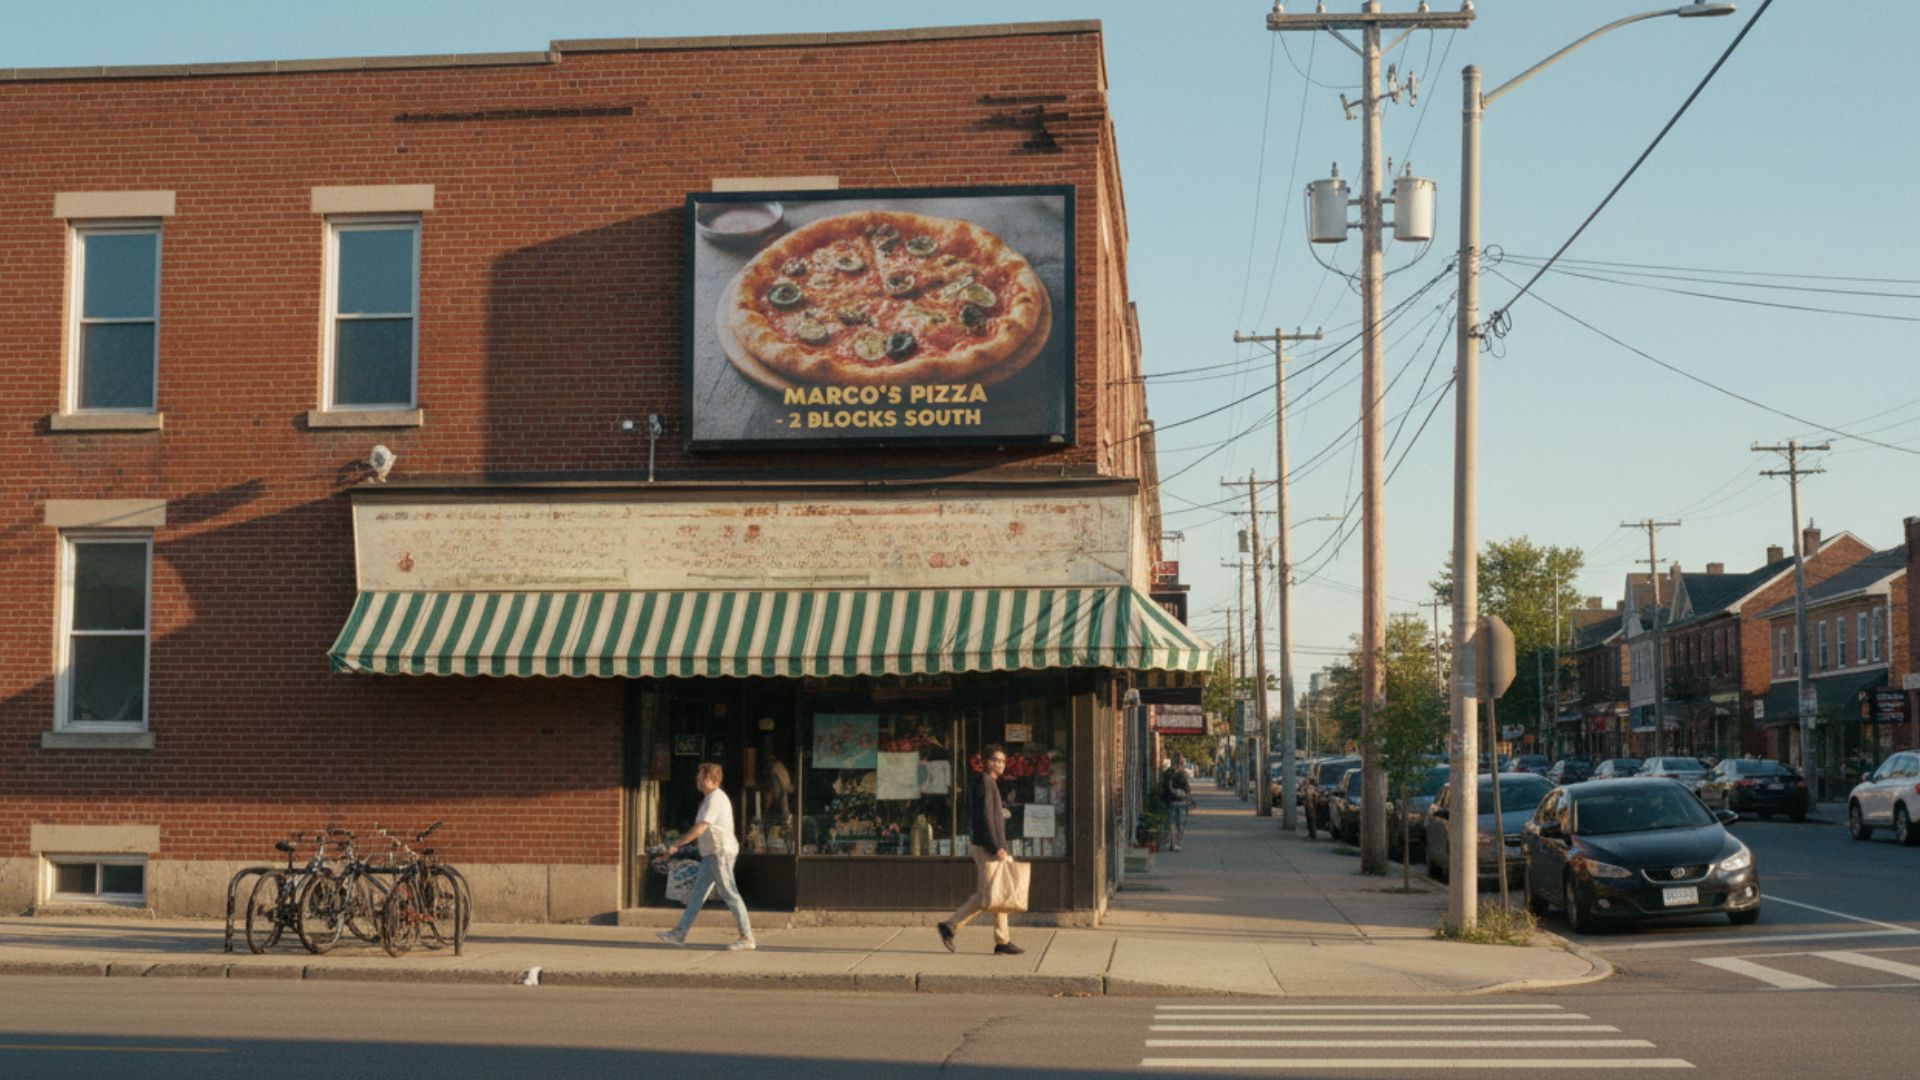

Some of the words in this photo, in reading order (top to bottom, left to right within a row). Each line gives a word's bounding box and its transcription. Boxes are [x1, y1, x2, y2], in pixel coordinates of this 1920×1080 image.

[784, 385, 901, 405] MARCO'S
[911, 384, 987, 404] PIZZA
[789, 412, 801, 428] 2
[808, 410, 897, 428] BLOCKS
[904, 409, 981, 427] SOUTH
